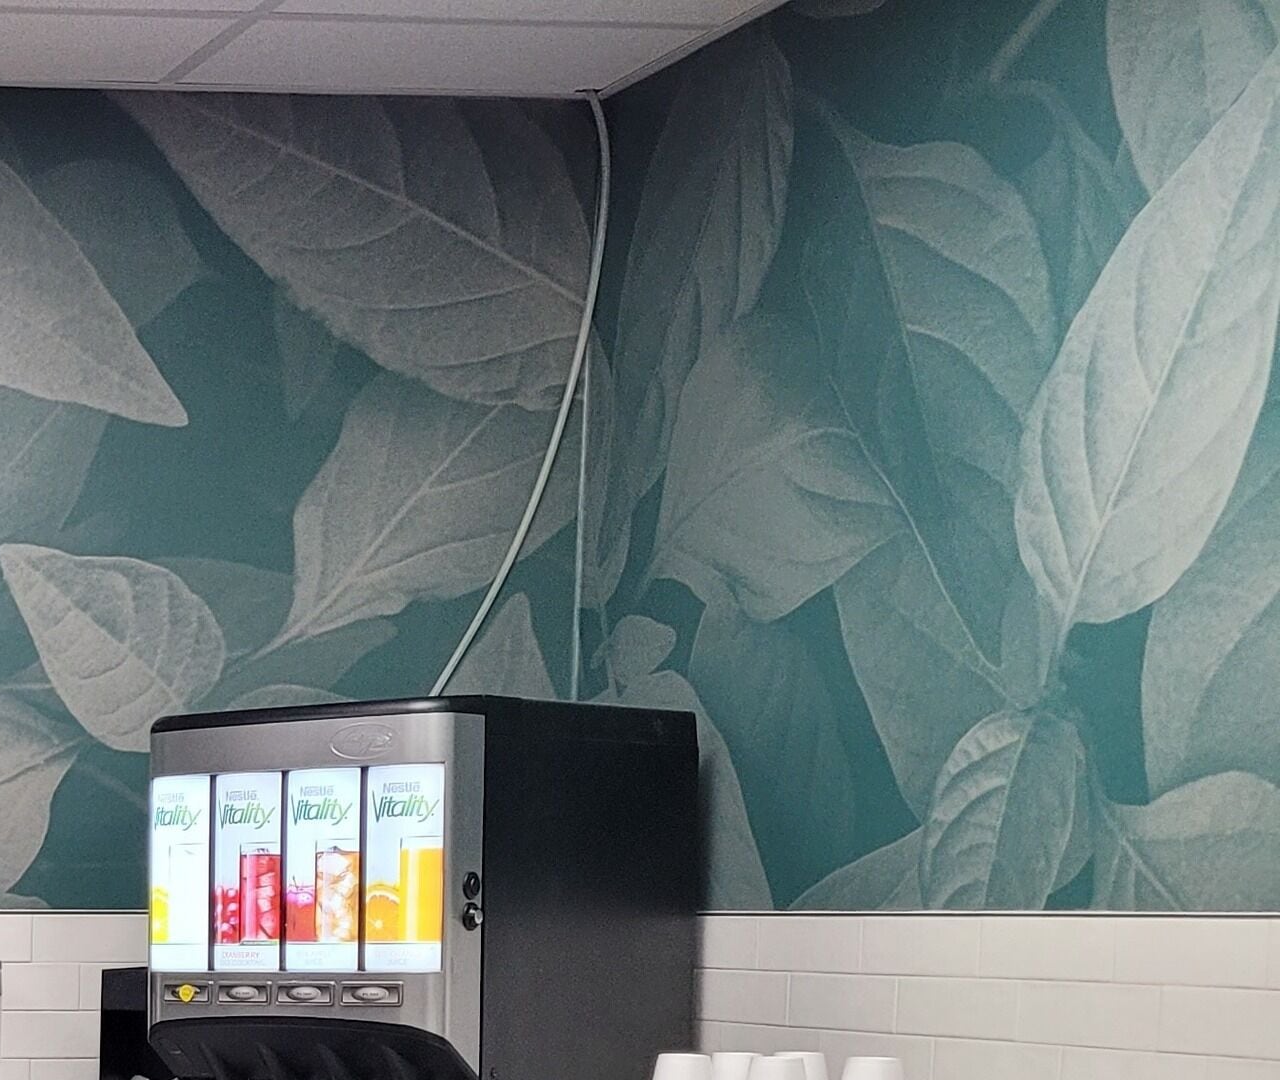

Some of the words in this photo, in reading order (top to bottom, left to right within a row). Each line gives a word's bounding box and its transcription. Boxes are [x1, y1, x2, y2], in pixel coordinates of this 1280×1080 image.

[300, 785, 335, 797] Nestlé
[383, 782, 422, 794] Nestlé
[218, 798, 276, 830] Vitality
[291, 794, 353, 826] Vitality
[372, 790, 440, 823] Vitality
